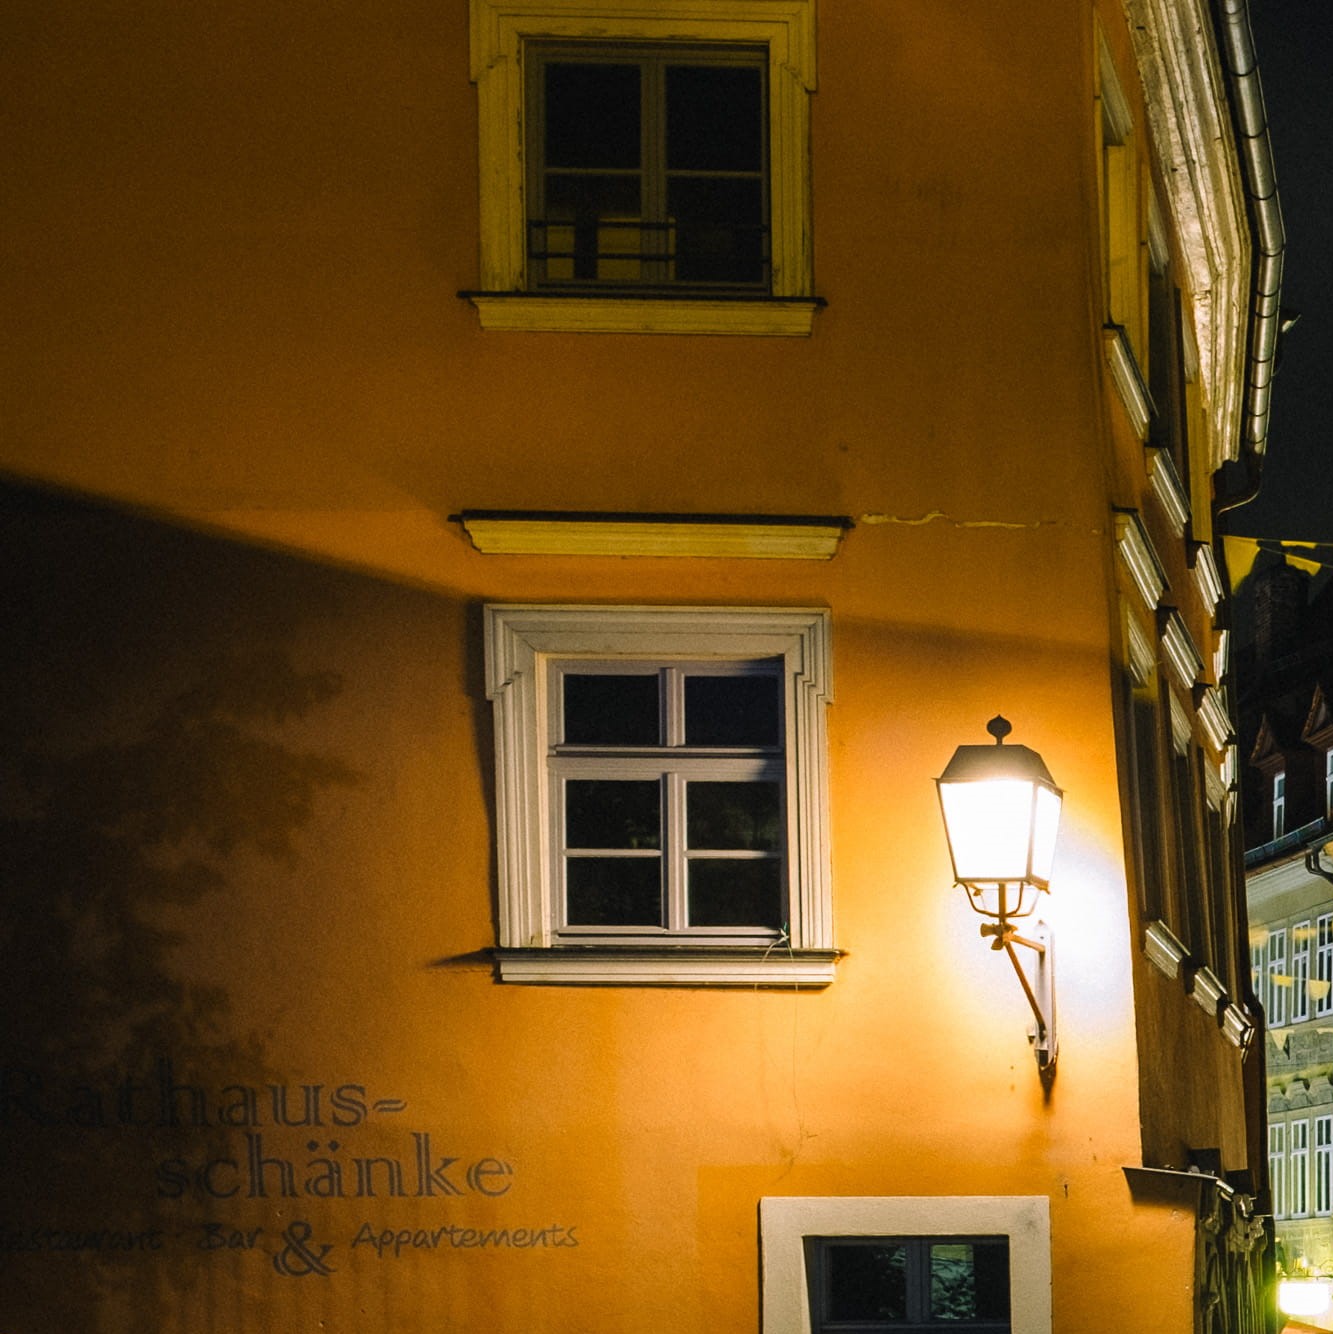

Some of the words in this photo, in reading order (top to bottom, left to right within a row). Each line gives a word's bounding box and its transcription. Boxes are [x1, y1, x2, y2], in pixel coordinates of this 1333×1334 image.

[0, 1055, 408, 1128] Rathaus-
[155, 1132, 515, 1199] schänke
[197, 1222, 262, 1251] Bar
[272, 1220, 337, 1277] &
[351, 1222, 579, 1258] Appartements
